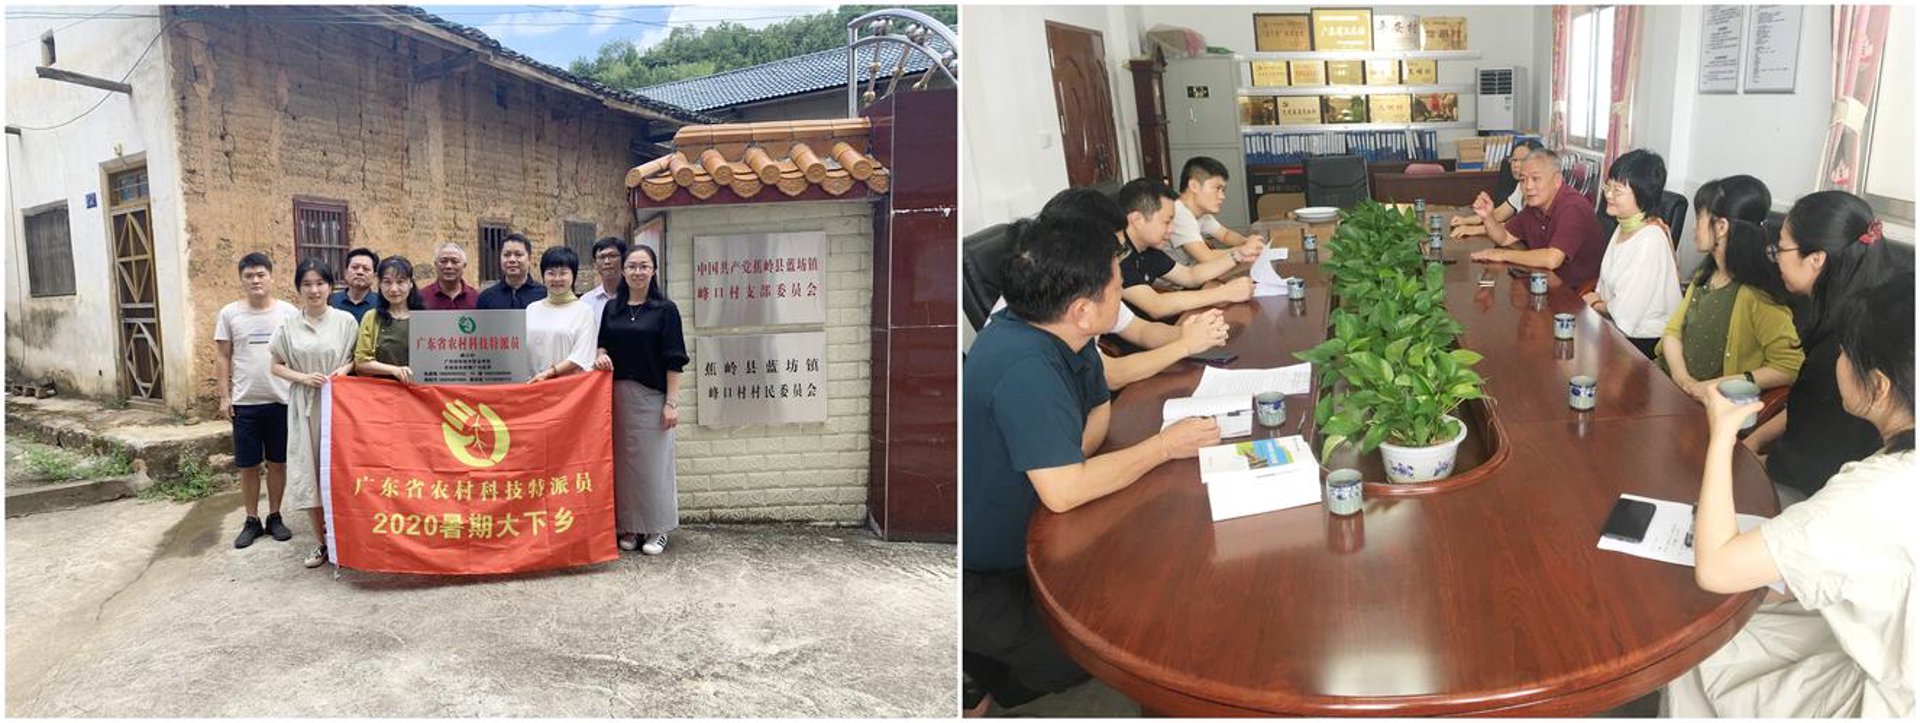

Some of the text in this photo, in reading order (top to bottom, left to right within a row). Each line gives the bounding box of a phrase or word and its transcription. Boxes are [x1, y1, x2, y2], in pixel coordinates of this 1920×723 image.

[697, 257, 818, 276] 中国共产党蕉岭县蓝坊镇
[697, 282, 818, 300] 峰口村支部委员会
[416, 335, 520, 351] 广东省农村科技特派员
[704, 358, 820, 377] 蕉岭县蓝坊镇
[708, 382, 818, 400] 峰口村村民委员会
[354, 472, 593, 501] 广东省农村科技特派员
[372, 506, 575, 540] 2020暑期大下乡
